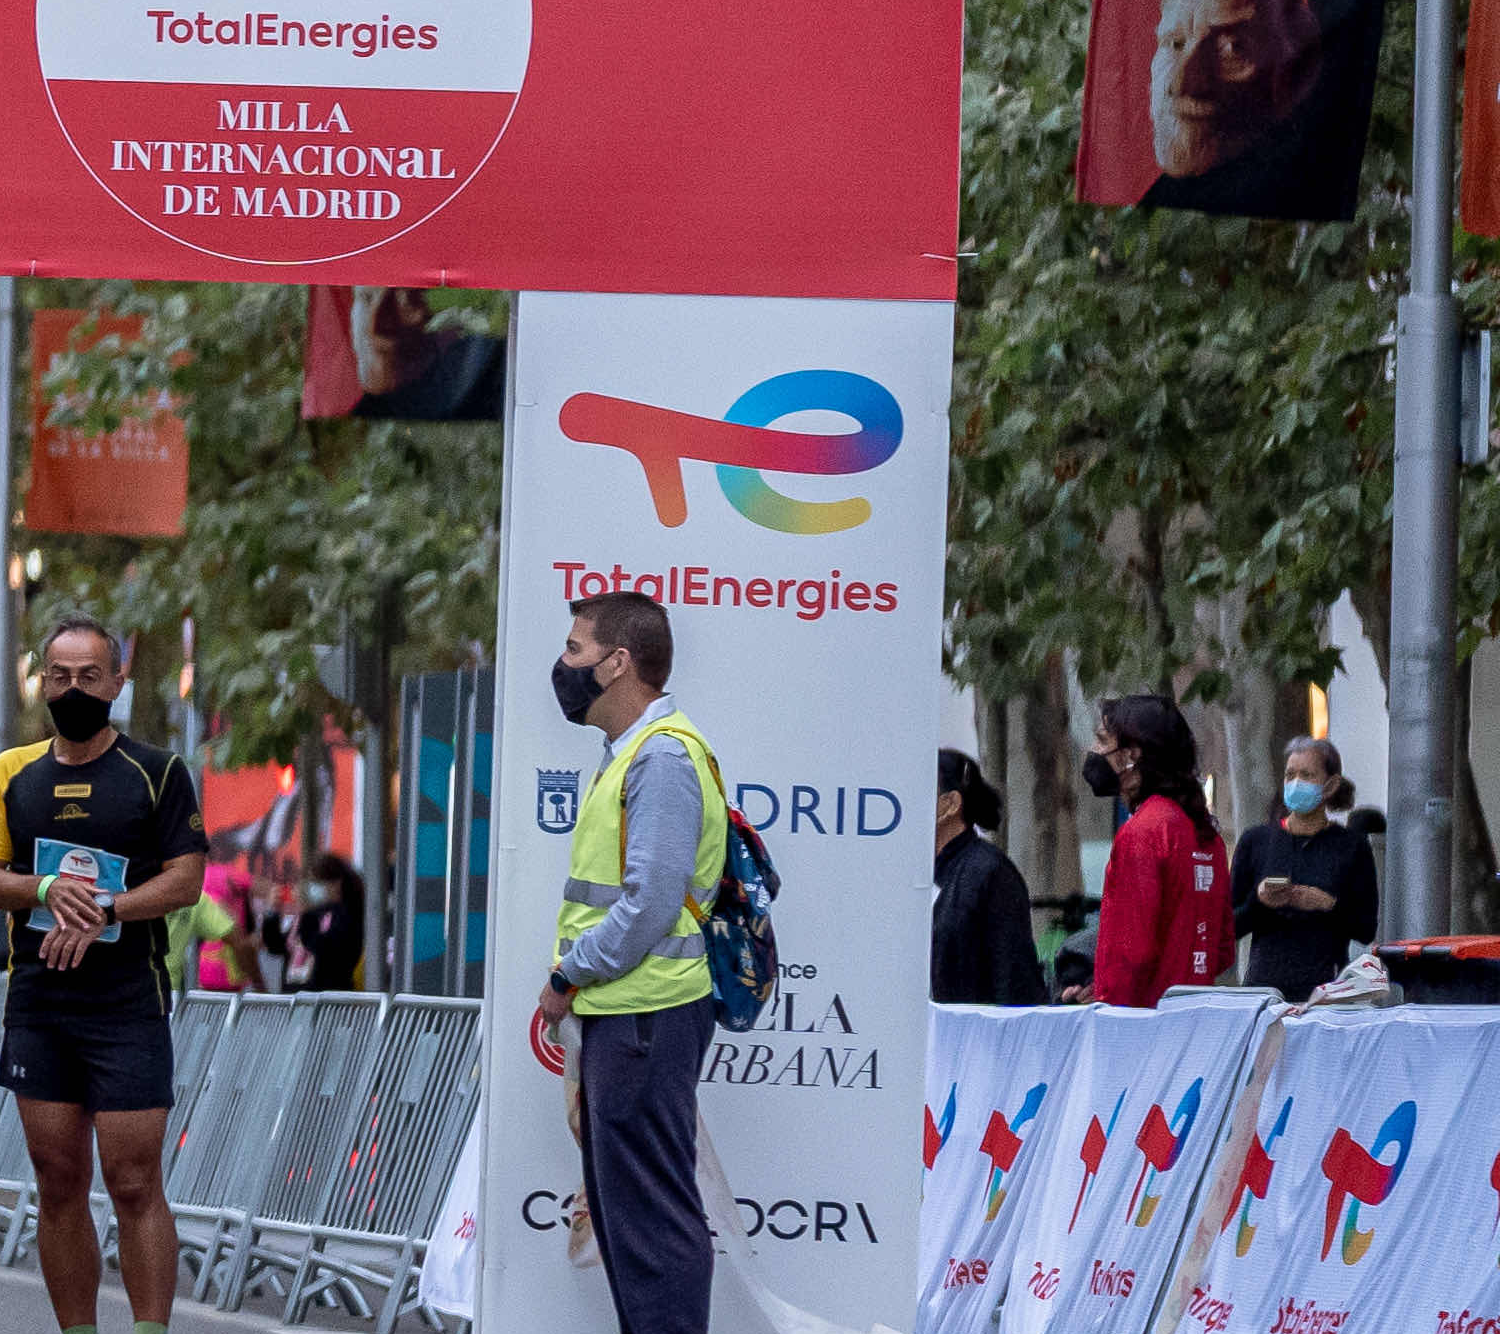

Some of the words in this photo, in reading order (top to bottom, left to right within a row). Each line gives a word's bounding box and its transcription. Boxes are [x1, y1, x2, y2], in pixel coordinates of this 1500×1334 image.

[146, 10, 439, 58] TotalEnergies
[216, 99, 353, 134] MILLA
[161, 184, 222, 217] DE
[231, 185, 402, 221] MADRID
[552, 561, 899, 621] TotalEnergies
[735, 783, 903, 837] DRID
[700, 1042, 883, 1090] RBANA
